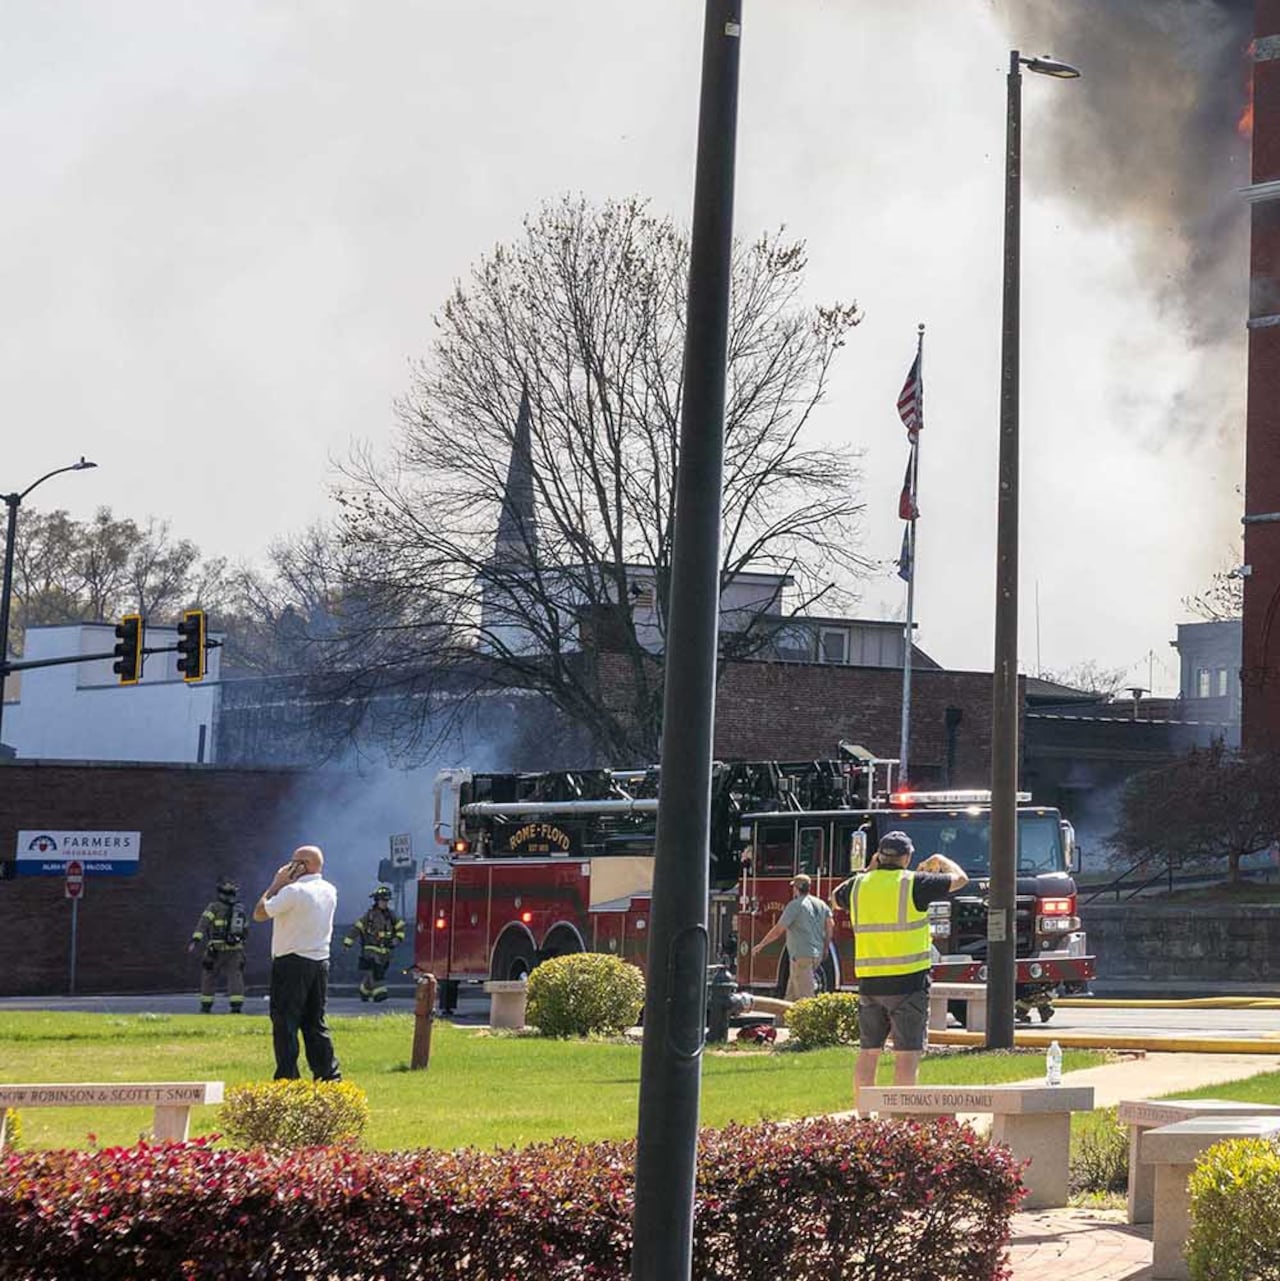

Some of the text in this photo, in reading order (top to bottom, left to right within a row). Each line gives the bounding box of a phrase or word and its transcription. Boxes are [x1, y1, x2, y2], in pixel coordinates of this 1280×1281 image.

[63, 837, 131, 847] FARMERS
[31, 1090, 94, 1102] ROBINSON
[99, 1091, 108, 1101] &
[111, 1090, 154, 1101] SCOTT
[167, 1089, 202, 1100] SNOW
[883, 1094, 897, 1106] THE
[900, 1094, 932, 1106] THOMAS
[966, 1094, 993, 1107] FAMILY
